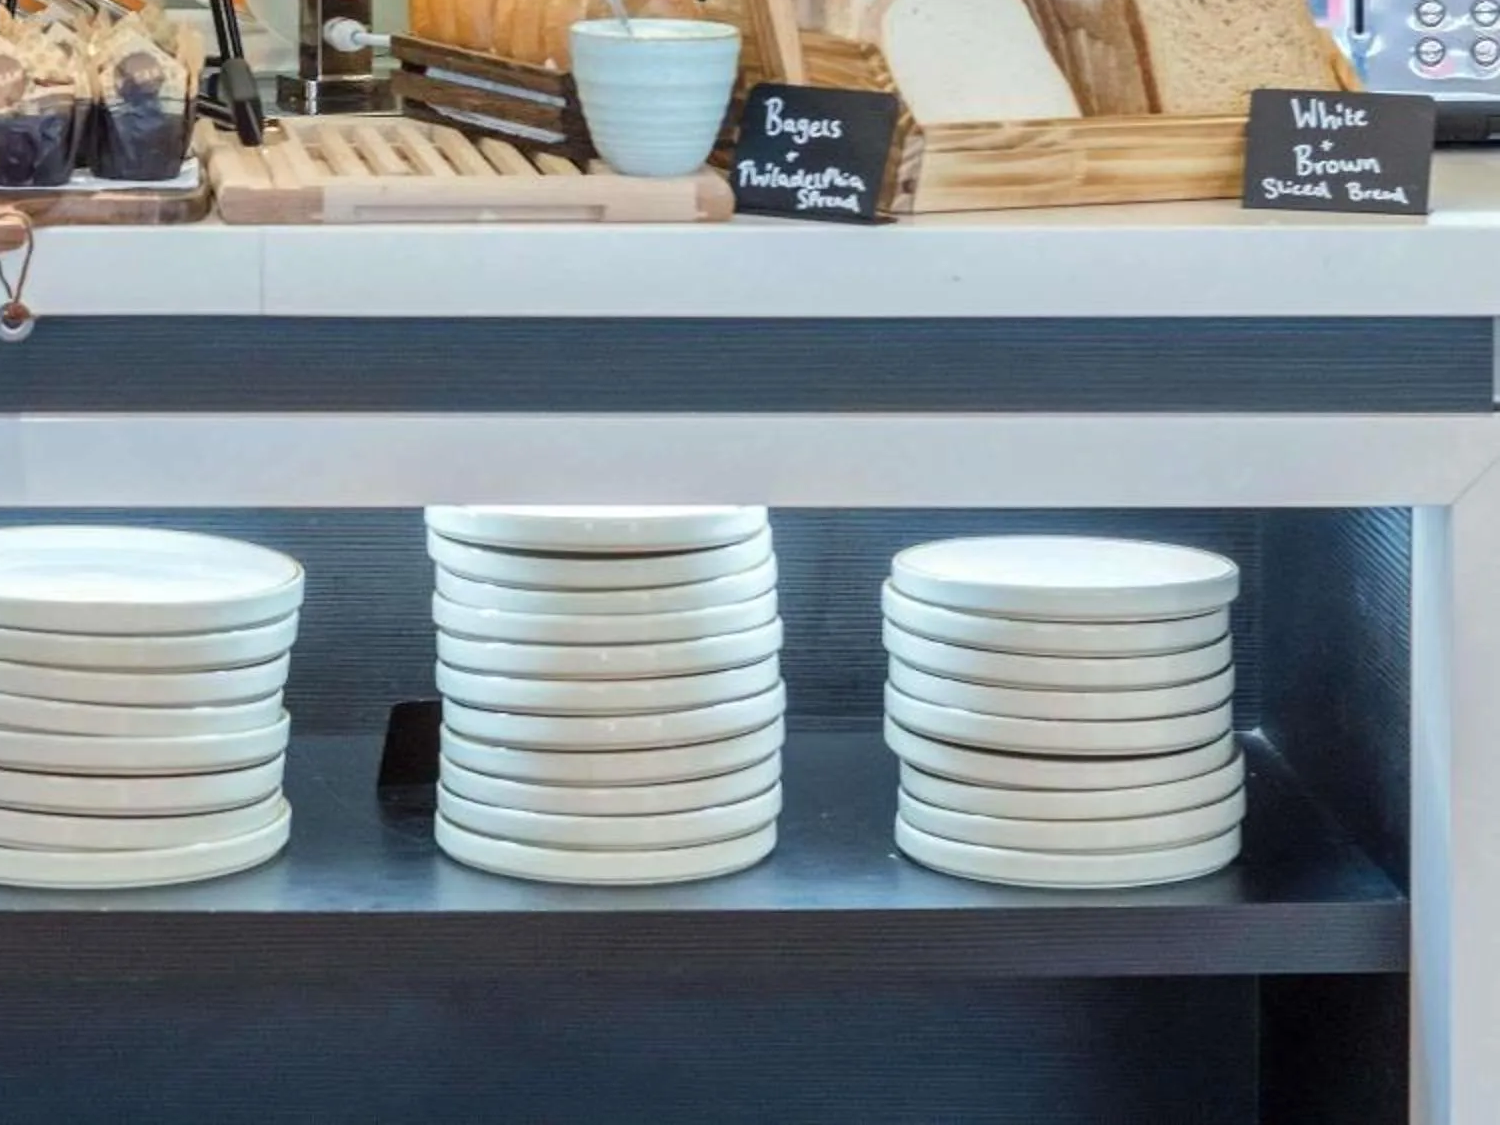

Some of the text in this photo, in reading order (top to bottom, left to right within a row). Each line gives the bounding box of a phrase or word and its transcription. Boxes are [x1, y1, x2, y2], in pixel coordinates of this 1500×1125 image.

[764, 96, 843, 145] Bagels
[1290, 97, 1369, 130] White
[1292, 144, 1381, 176] Brown
[1261, 177, 1410, 205] Sliced Bread
